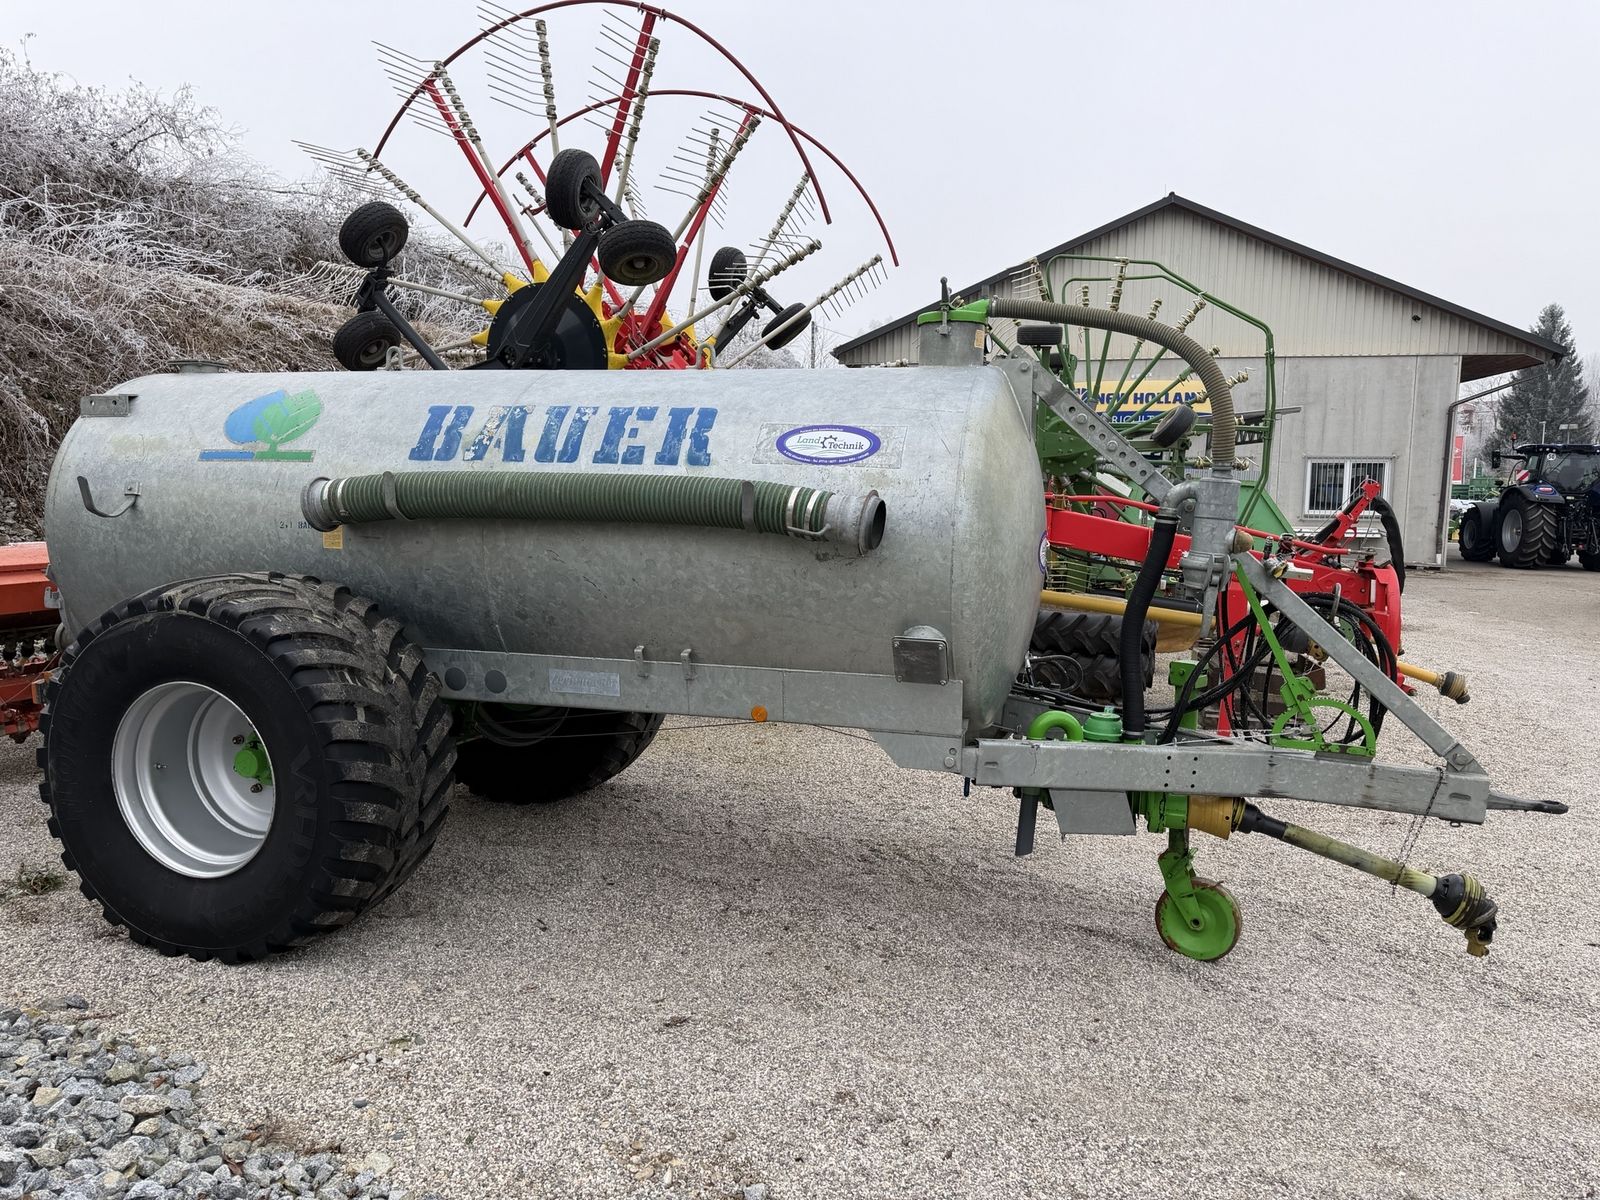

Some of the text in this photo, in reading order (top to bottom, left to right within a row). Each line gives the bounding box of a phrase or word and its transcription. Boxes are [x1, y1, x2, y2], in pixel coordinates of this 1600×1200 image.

[1097, 392, 1204, 404] NEW HOLLAN
[408, 405, 718, 466] BAUER
[796, 435, 821, 444] Land
[828, 441, 864, 449] Technik
